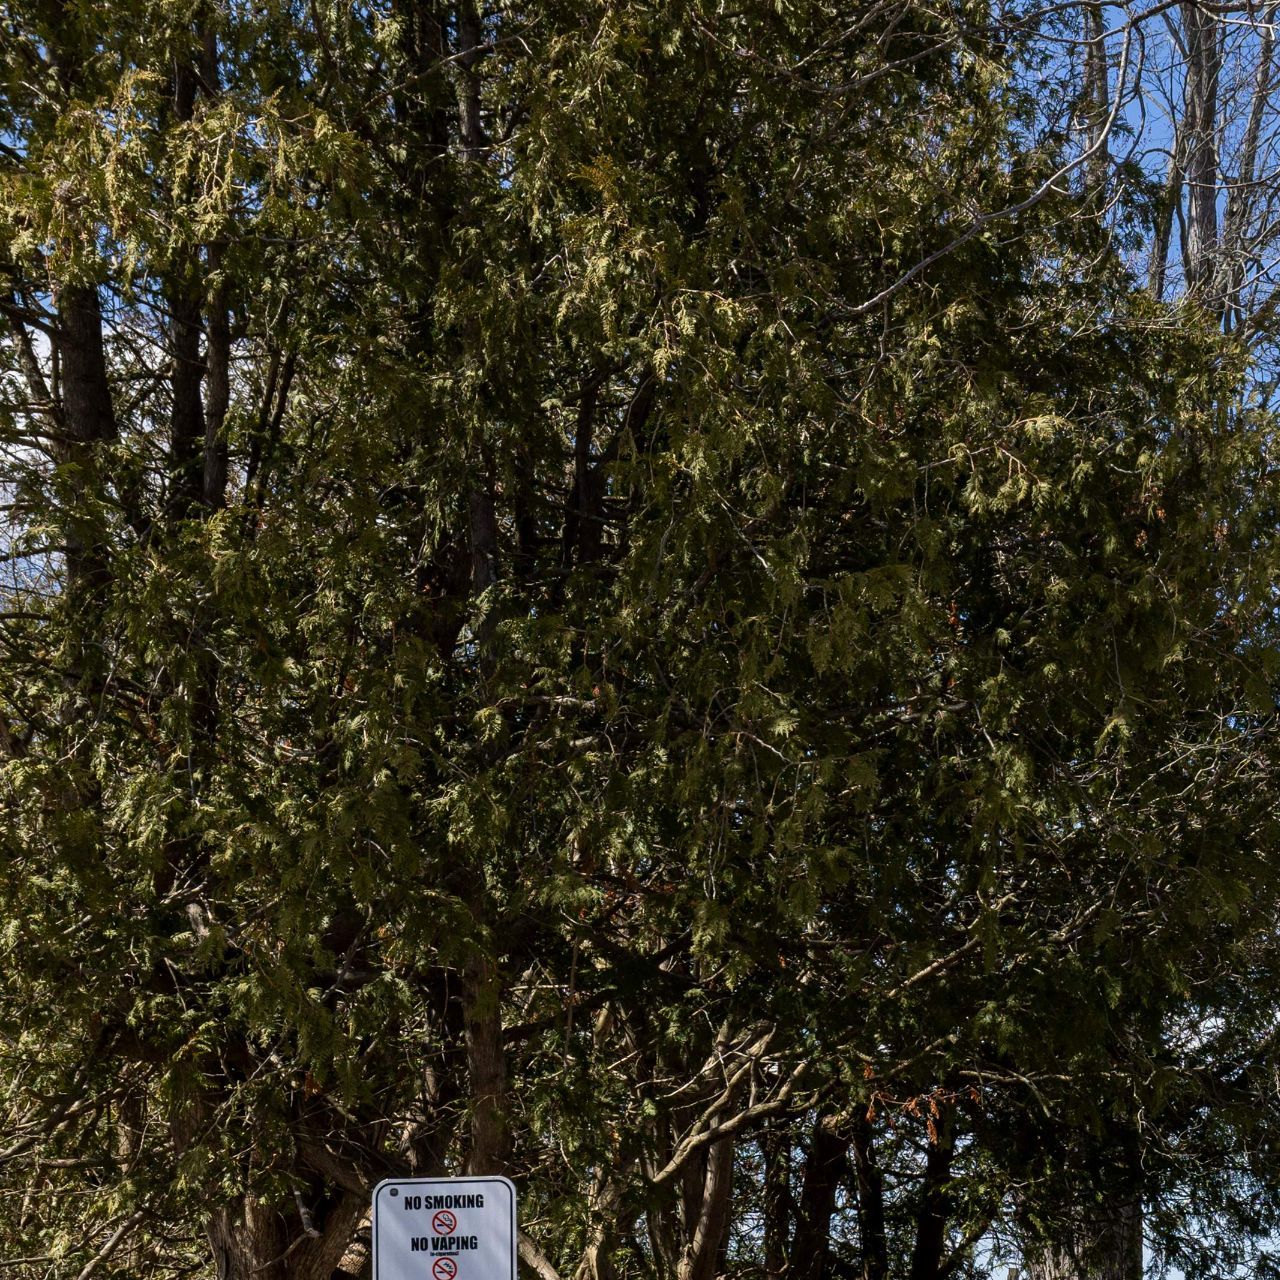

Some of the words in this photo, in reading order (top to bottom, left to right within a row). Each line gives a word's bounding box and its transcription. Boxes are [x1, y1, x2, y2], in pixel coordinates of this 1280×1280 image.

[405, 1196, 421, 1210] NO
[425, 1194, 483, 1209] SMOKING
[412, 1237, 428, 1251] NO
[431, 1236, 477, 1250] VAPING
